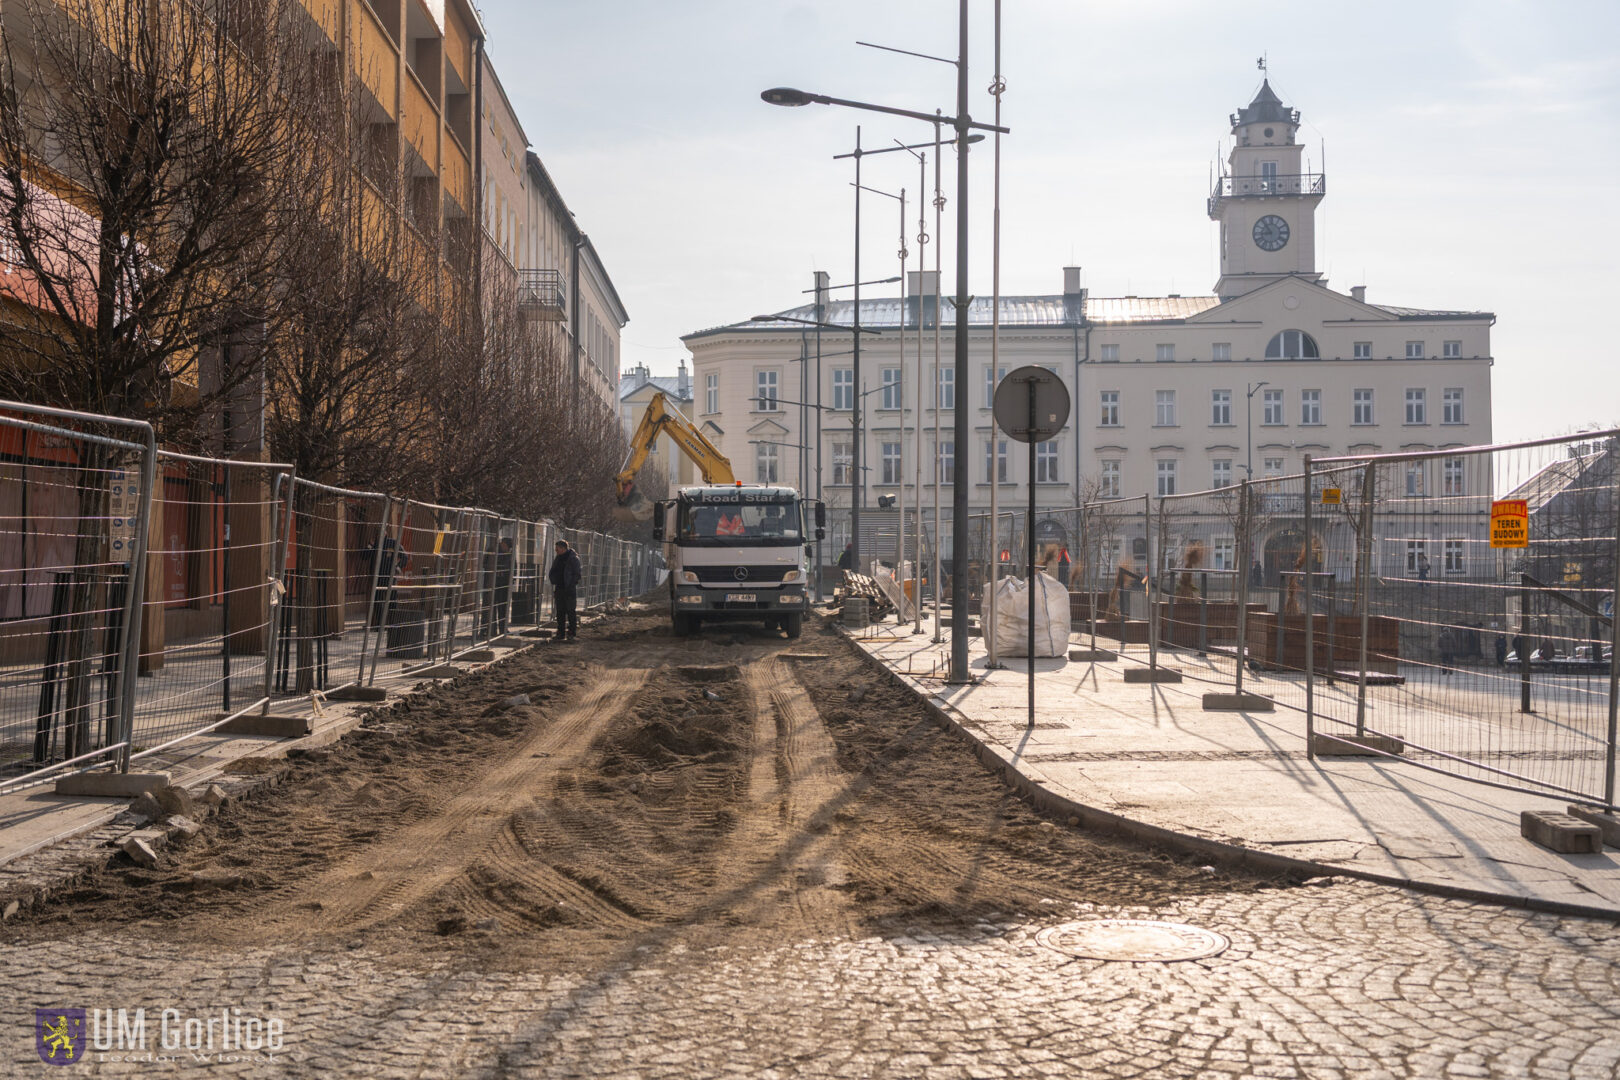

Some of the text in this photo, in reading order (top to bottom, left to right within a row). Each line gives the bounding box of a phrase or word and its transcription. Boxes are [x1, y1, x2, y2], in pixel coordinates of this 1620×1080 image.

[702, 494, 775, 503] Road Star
[1497, 519, 1521, 528] TEREN
[1493, 529, 1525, 538] BUDOWY
